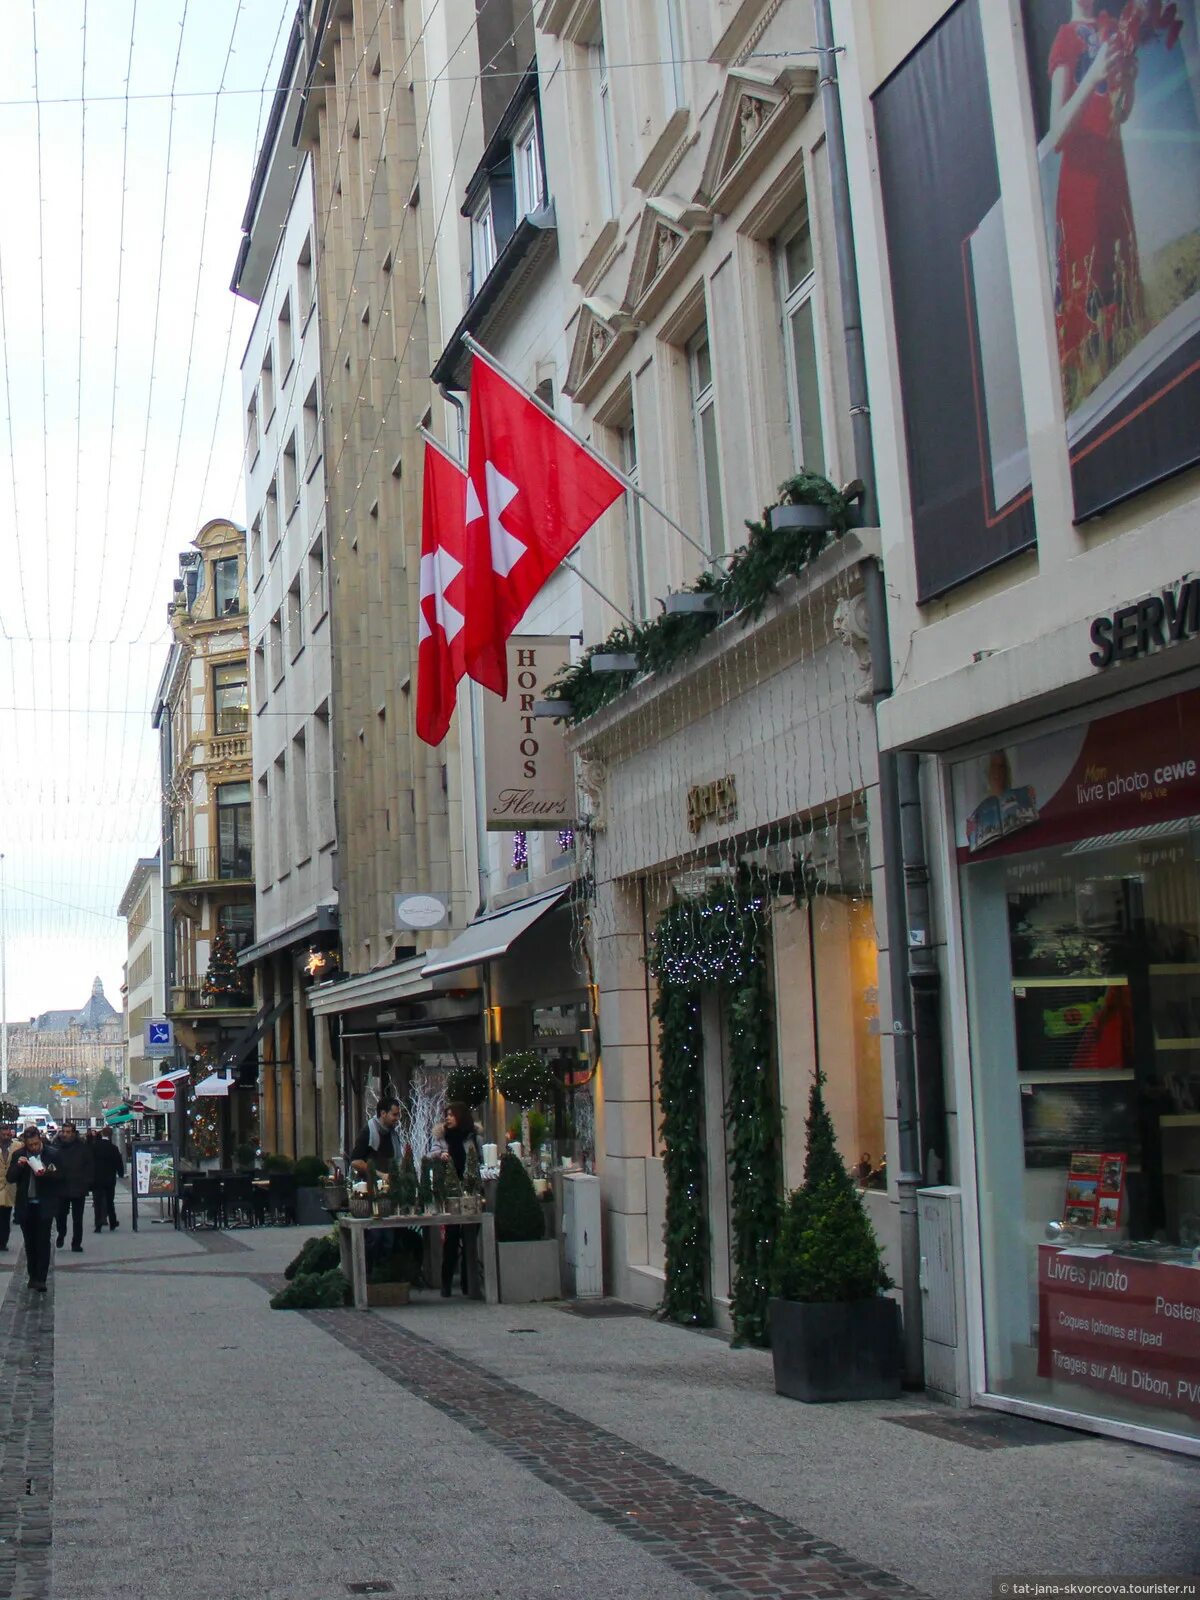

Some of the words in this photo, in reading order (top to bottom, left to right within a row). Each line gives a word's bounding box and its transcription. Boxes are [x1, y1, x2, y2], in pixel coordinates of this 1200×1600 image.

[516, 649, 540, 779] HORTOS
[492, 788, 568, 815] Fleurs
[1076, 783, 1105, 804] livre
[1107, 771, 1149, 801] photo
[1153, 760, 1197, 785] cewe
[1047, 1256, 1087, 1284] Livres
[1088, 1266, 1129, 1293] photo
[1058, 1311, 1090, 1332] Coques
[1091, 1317, 1126, 1340] Iphones
[1127, 1328, 1138, 1342] et
[1139, 1328, 1163, 1347] Ipad
[1051, 1349, 1088, 1376] Tirages
[1089, 1362, 1108, 1380] sur
[1108, 1364, 1128, 1385] Alu
[1131, 1369, 1173, 1400] Dibon,
